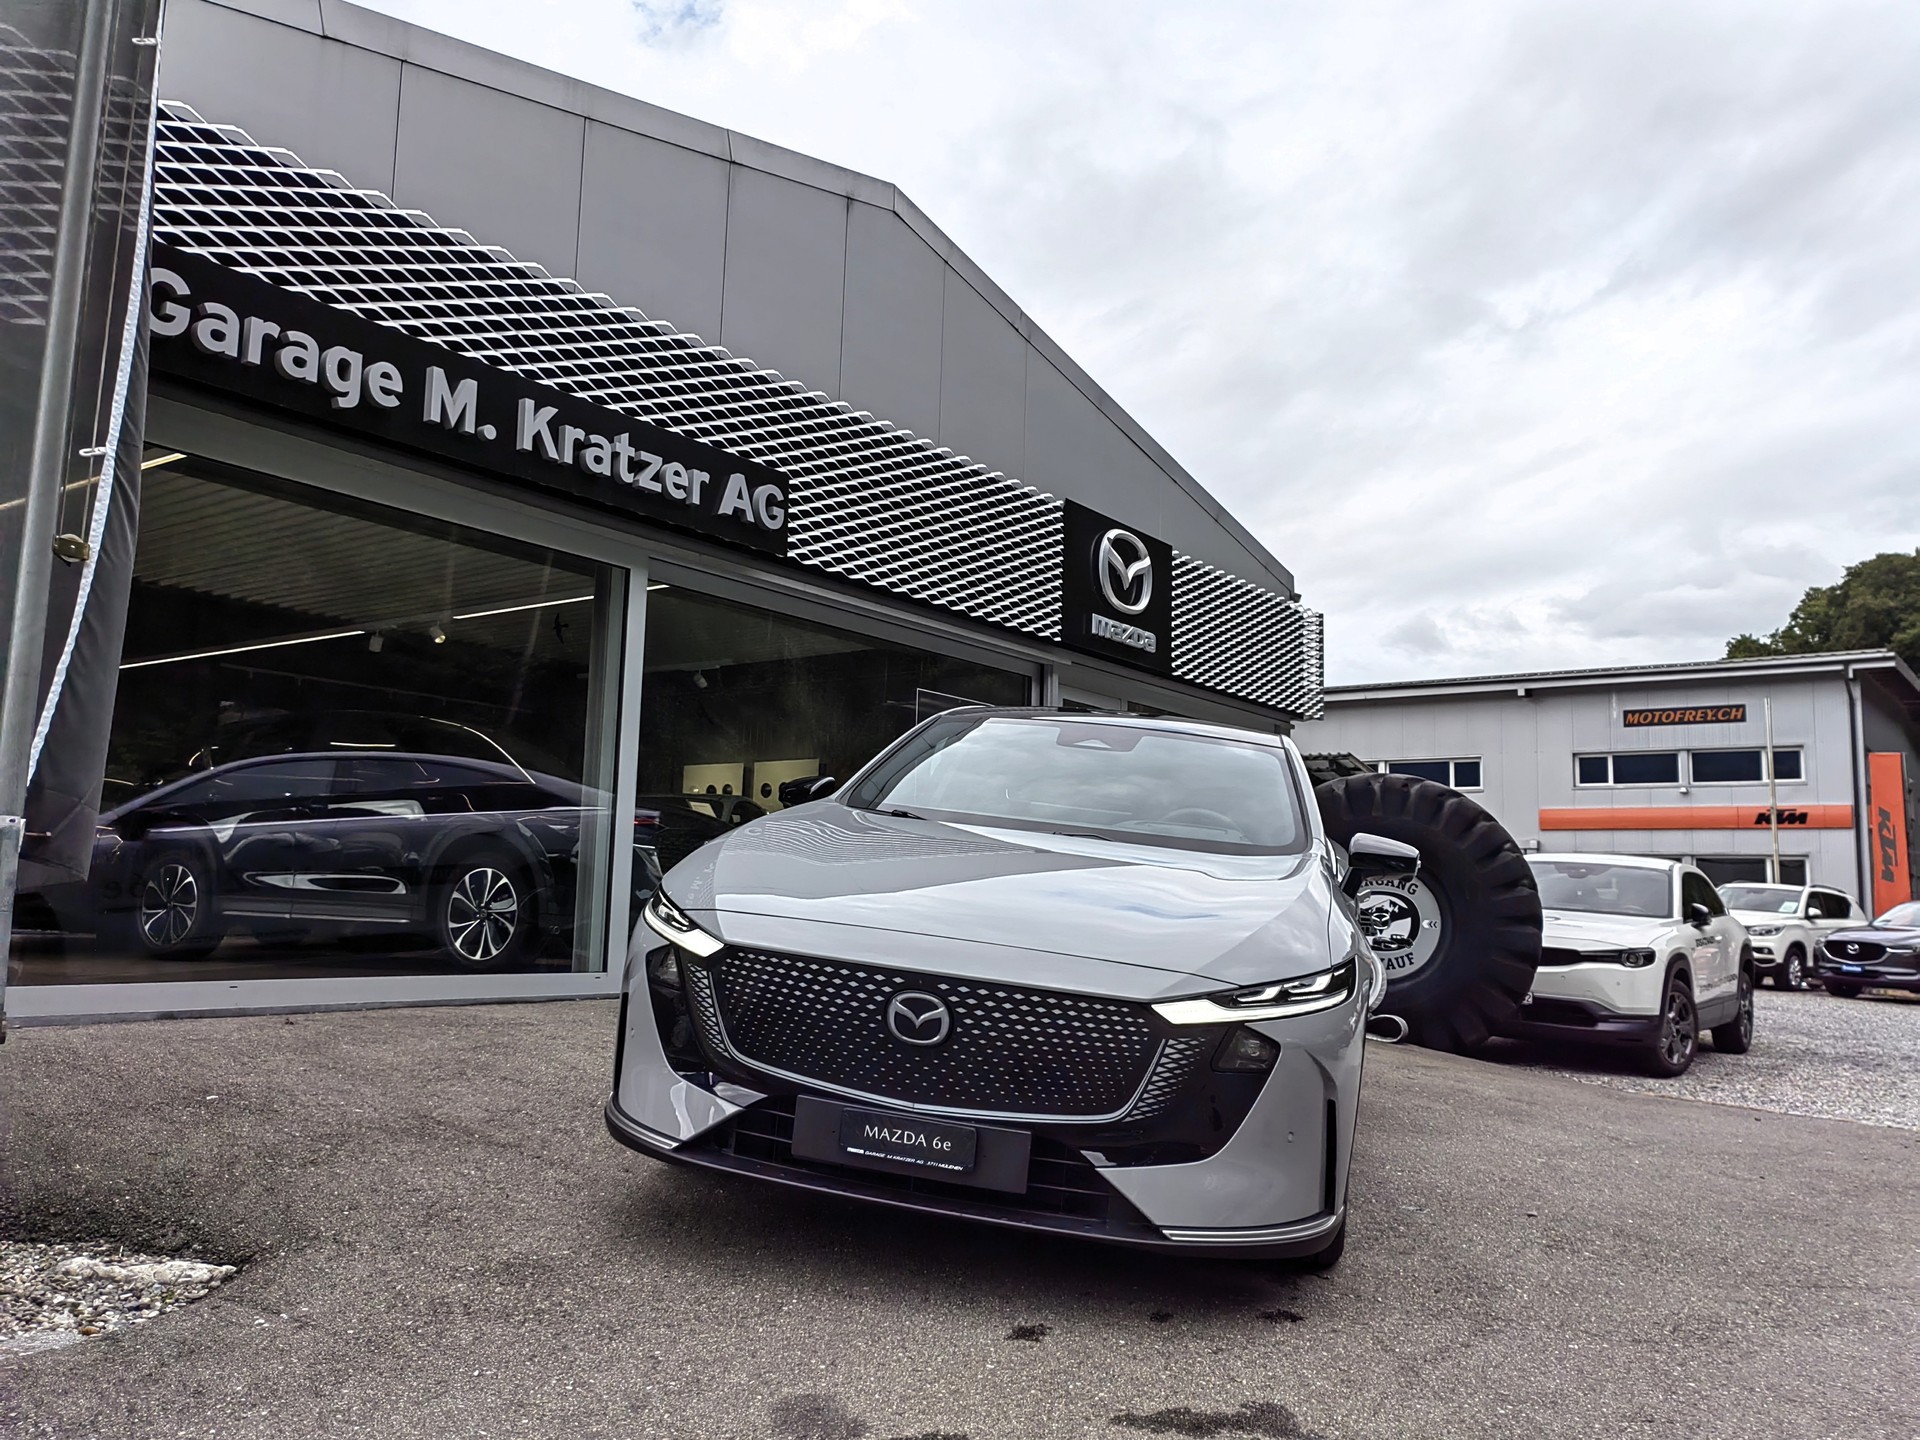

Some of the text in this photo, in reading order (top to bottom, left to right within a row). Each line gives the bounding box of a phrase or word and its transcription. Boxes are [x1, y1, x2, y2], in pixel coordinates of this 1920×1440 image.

[150, 267, 785, 530] Garage M. Kratzer AG
[1092, 612, 1157, 653] mazda
[1626, 708, 1744, 725] MOTOFREY.CH
[1754, 809, 1808, 825] KTM
[1878, 806, 1899, 883] KTM
[1361, 879, 1419, 896] NGANG
[864, 1125, 952, 1151] MAZDA 6e
